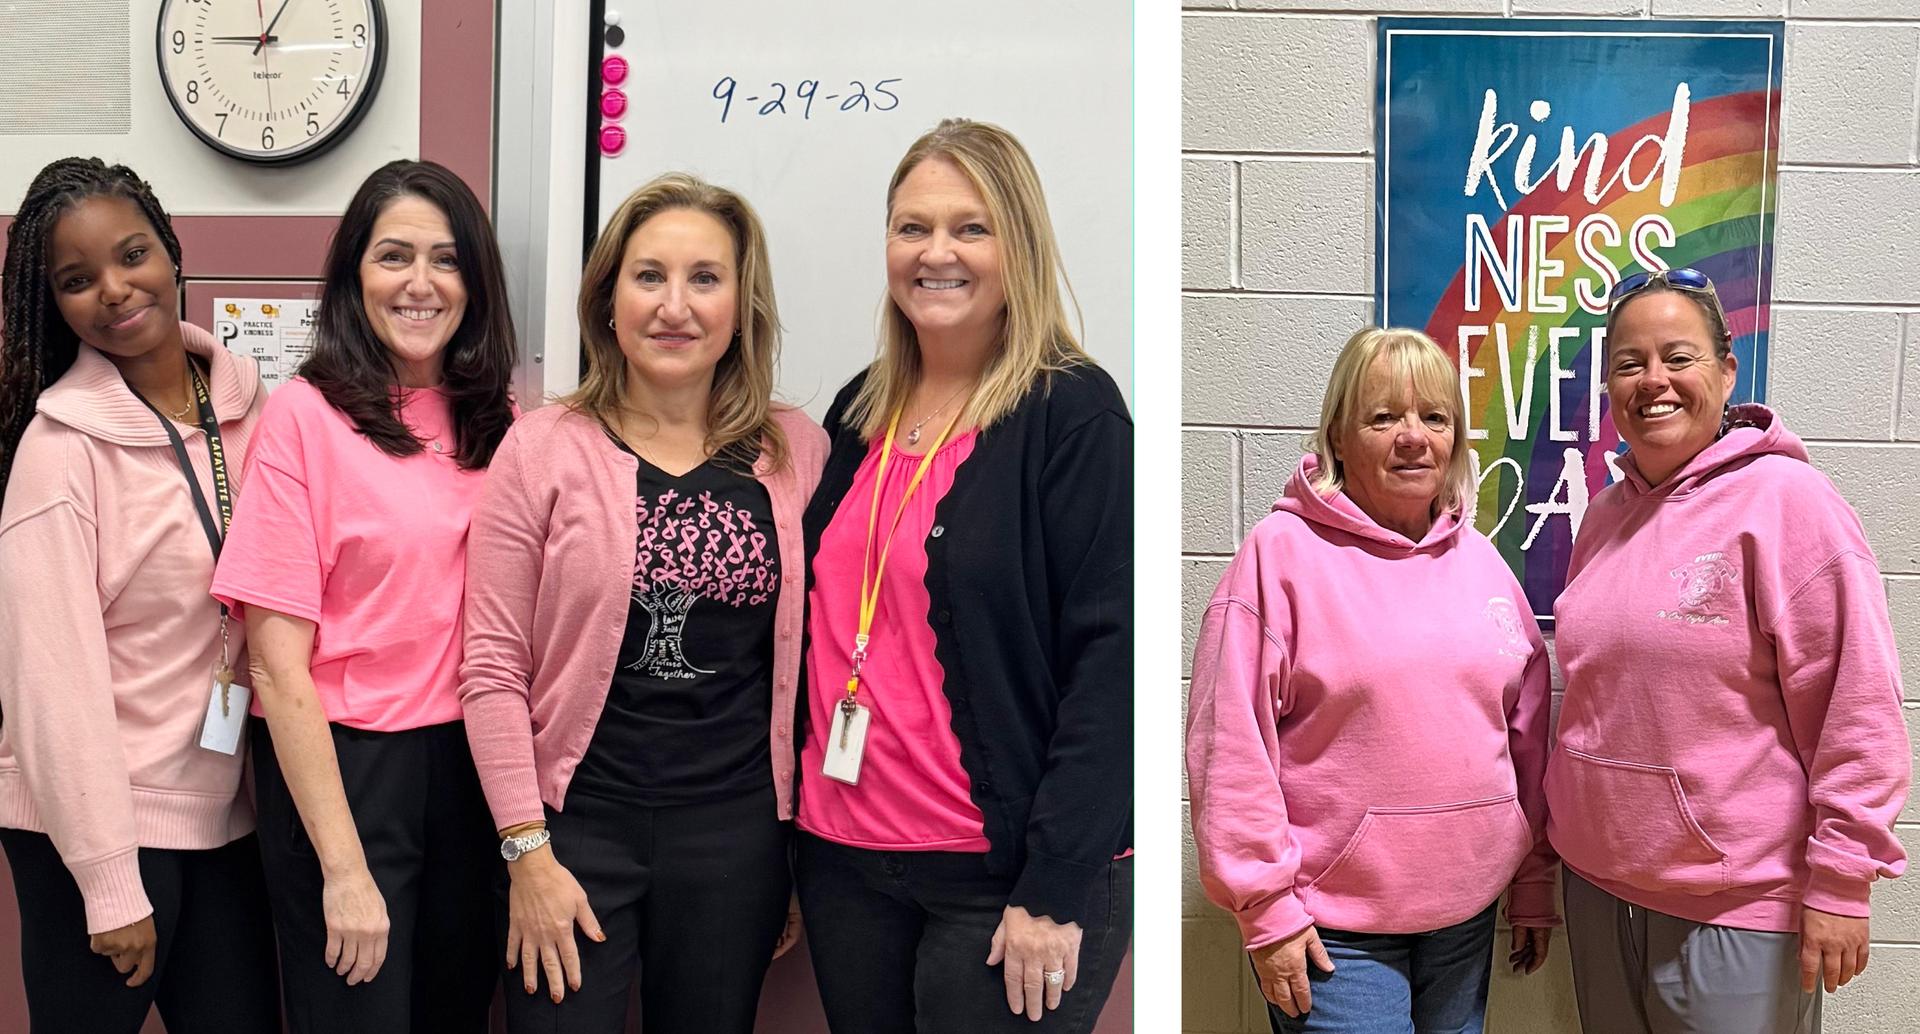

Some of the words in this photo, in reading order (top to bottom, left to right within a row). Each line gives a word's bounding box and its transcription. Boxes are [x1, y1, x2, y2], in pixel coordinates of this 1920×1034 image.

[172, 30, 185, 54] 9
[352, 23, 367, 48] 3
[186, 80, 199, 104] 8
[336, 75, 351, 100] 4
[713, 76, 902, 123] 9-29-25
[215, 113, 228, 137] 7
[306, 112, 320, 137] 5
[261, 126, 274, 150] 6
[1463, 81, 1691, 211] kind
[1464, 213, 1676, 316] NESS
[211, 436, 229, 502] LAFAYETTE
[1468, 447, 1626, 551] DA
[648, 666, 697, 681] Together
